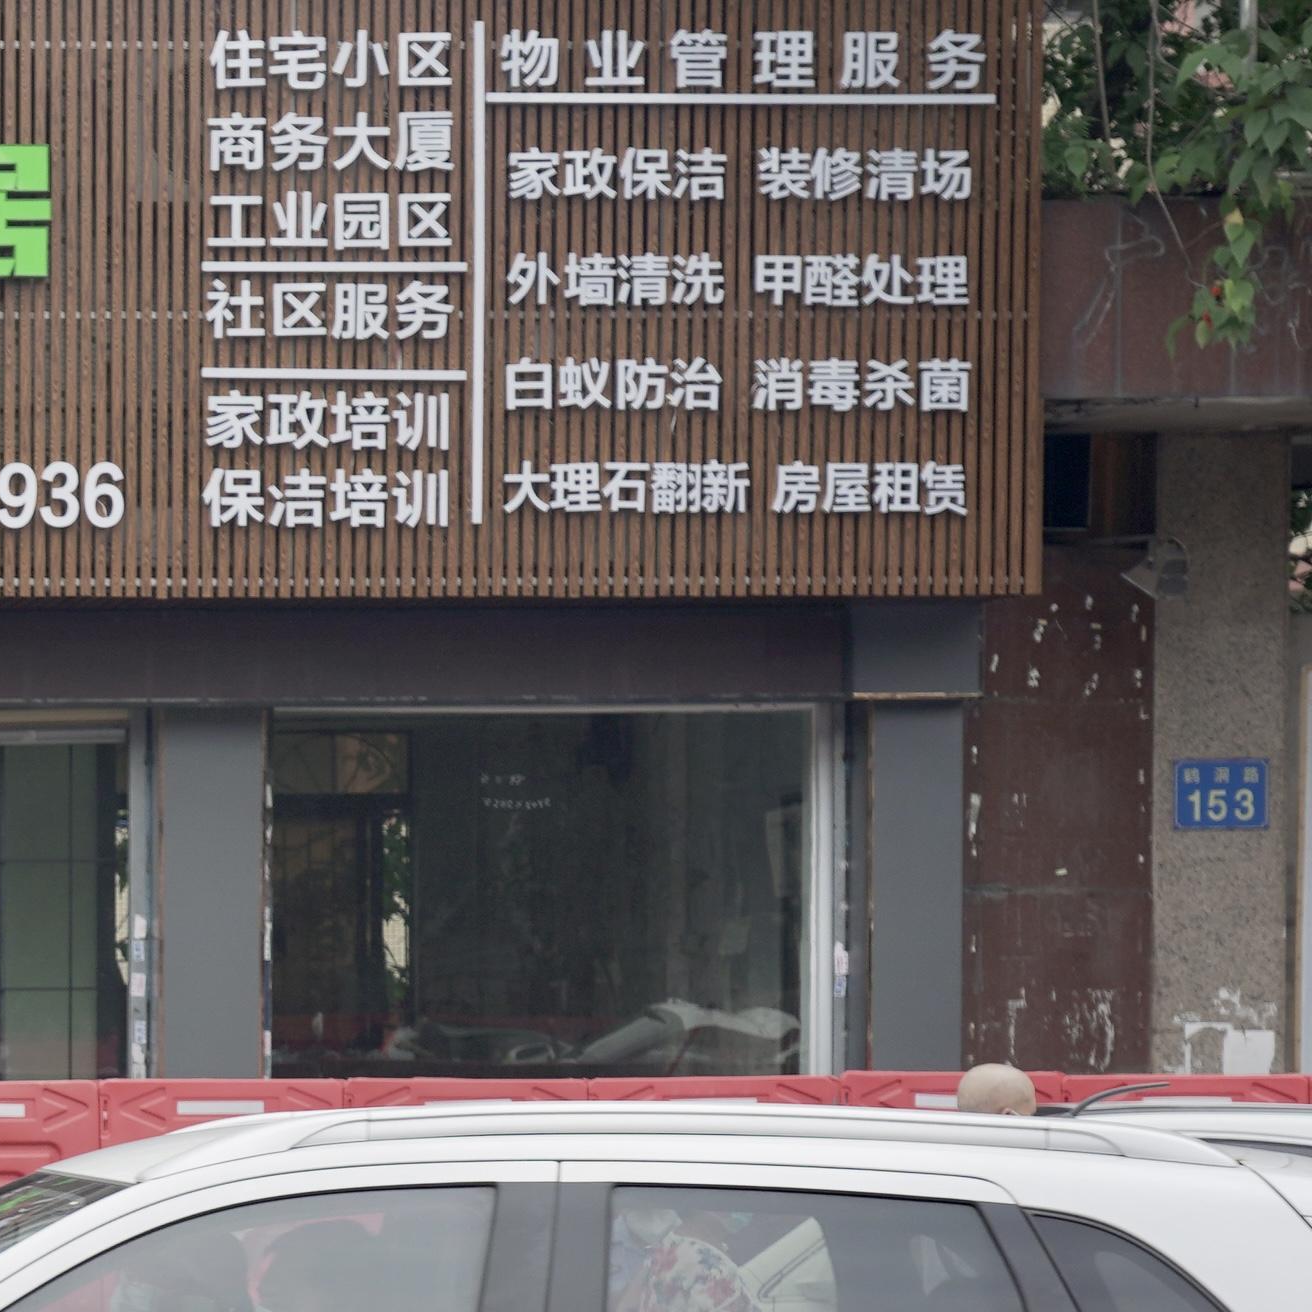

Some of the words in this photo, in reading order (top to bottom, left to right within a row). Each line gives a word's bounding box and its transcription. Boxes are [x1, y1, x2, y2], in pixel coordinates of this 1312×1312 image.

[210, 30, 452, 89] 住宅小区
[501, 30, 987, 89] 物业管理服务
[208, 111, 454, 171] 商务大厦
[508, 147, 726, 200] 家政保洁
[759, 148, 972, 200] 装修清场
[208, 191, 452, 250] 工业园区
[506, 252, 724, 305] 外墙清洗
[755, 254, 969, 306] 甲醛处理
[206, 279, 455, 340] 社区服务
[505, 357, 722, 411] 白蚁防治
[753, 358, 972, 412] 消毒杀菌
[205, 390, 449, 450] 家政培训
[203, 468, 449, 527] 保洁培训
[503, 459, 750, 513] 大理石翻新
[772, 461, 968, 515] 房屋租赁
[1187, 788, 1255, 821] 153
